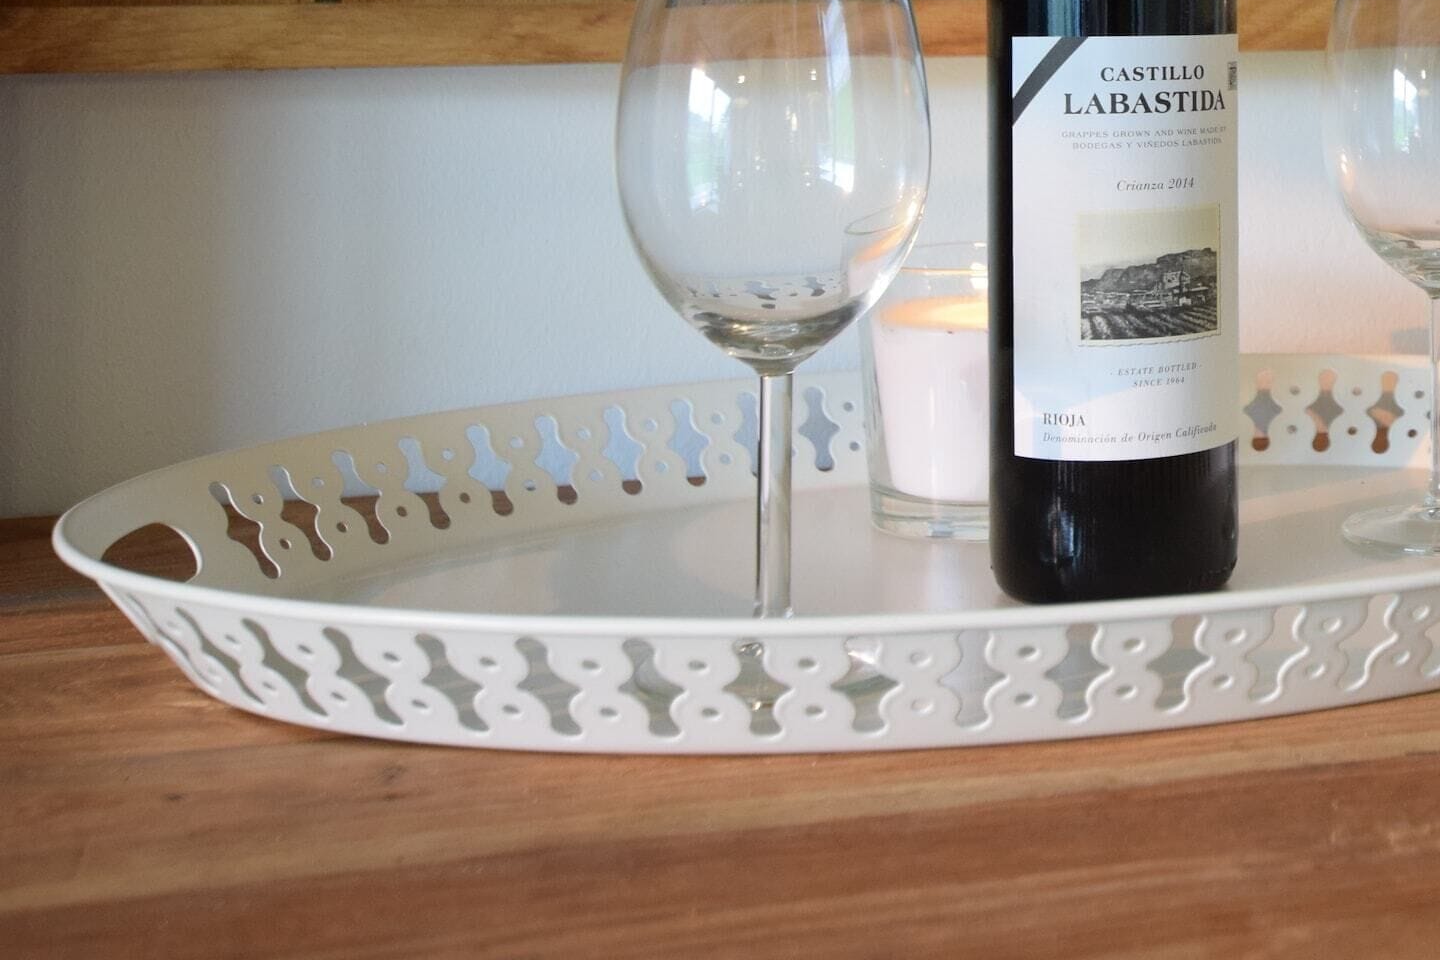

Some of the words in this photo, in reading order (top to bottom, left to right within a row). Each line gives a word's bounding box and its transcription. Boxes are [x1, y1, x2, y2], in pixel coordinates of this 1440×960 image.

[1100, 65, 1204, 82] CASTILLO
[1063, 89, 1225, 115] LABASTIDA
[1154, 128, 1174, 137] AND
[1116, 179, 1164, 192] Crianza
[1167, 176, 1195, 190] 2014
[1117, 367, 1155, 376] ESTATE
[1132, 378, 1163, 389] SINCE
[1042, 413, 1086, 427] RIOJA
[1120, 432, 1134, 443] de
[1137, 431, 1173, 444] Origen
